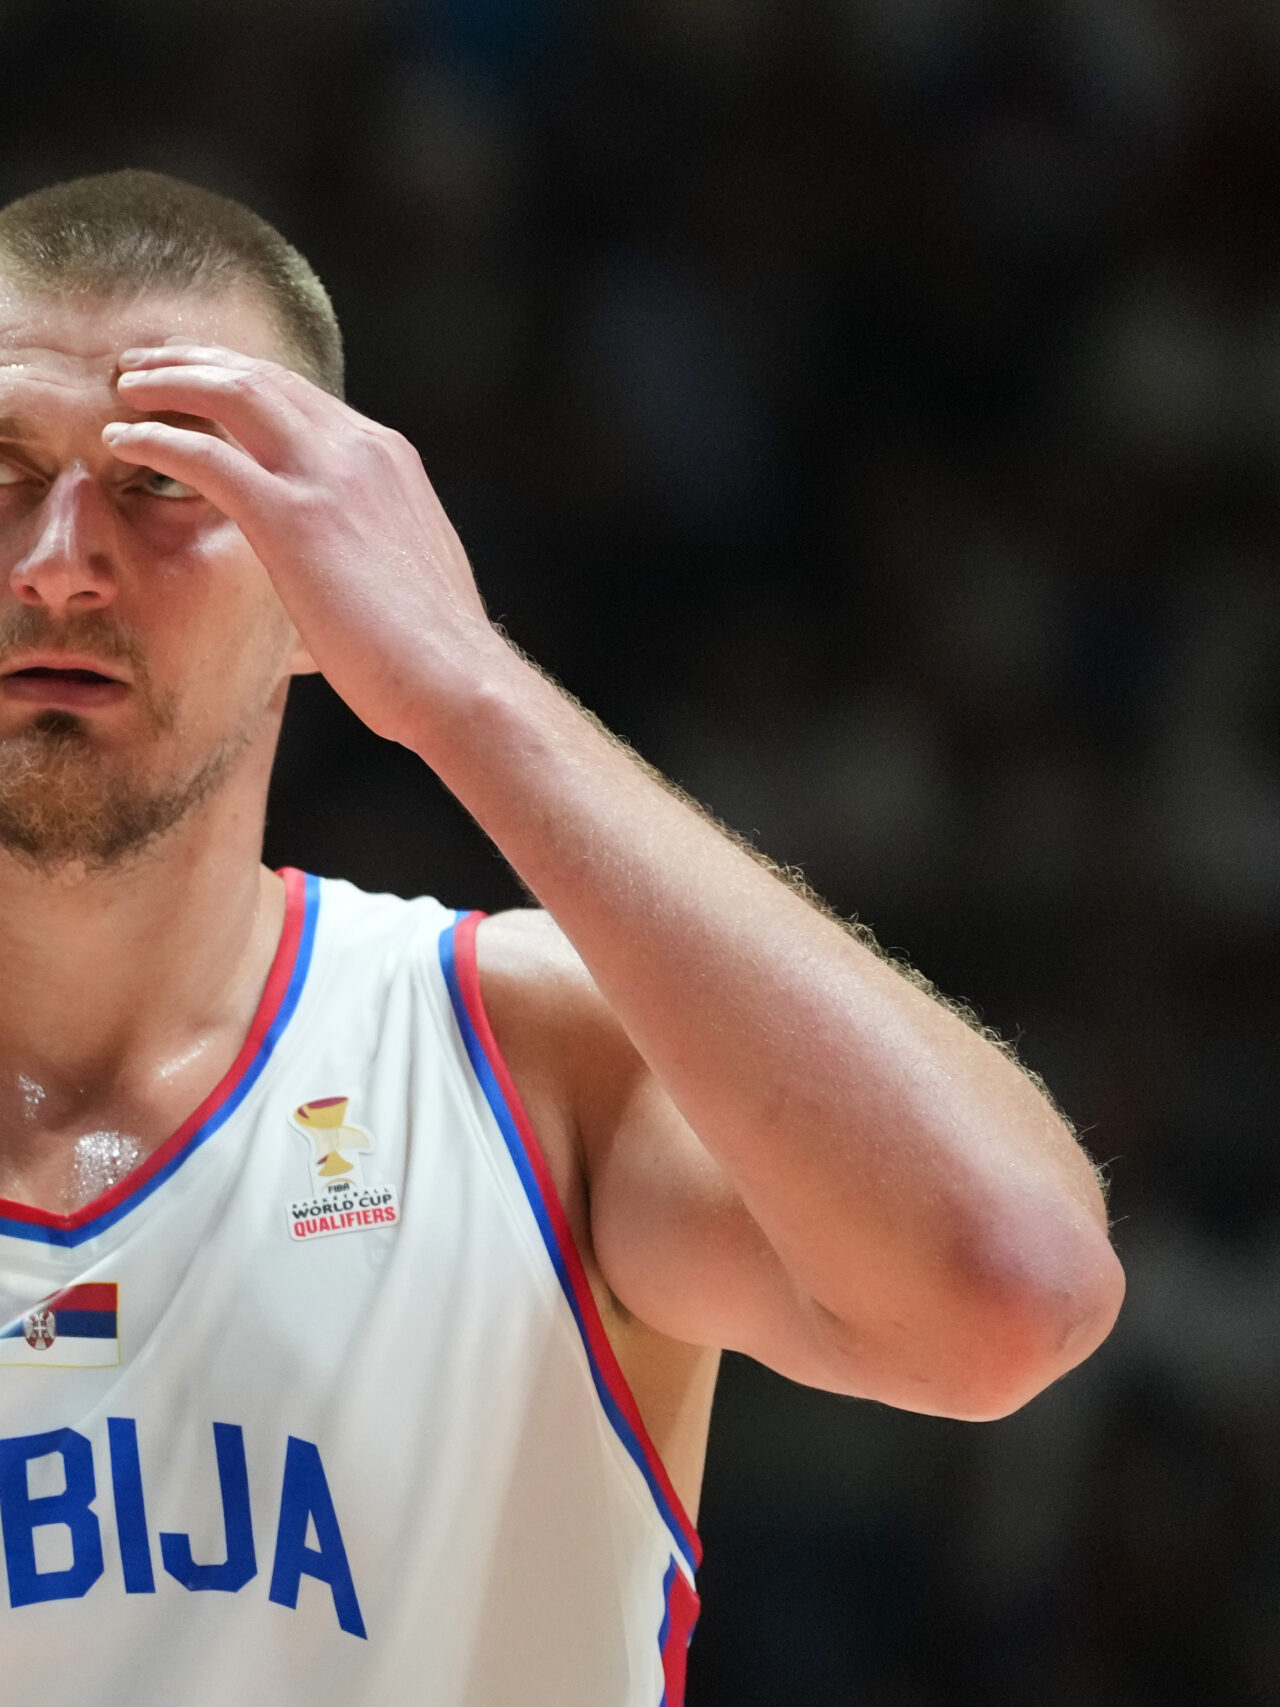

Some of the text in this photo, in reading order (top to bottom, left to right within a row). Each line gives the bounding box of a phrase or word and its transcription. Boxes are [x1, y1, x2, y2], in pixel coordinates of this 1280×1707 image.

[328, 1182, 350, 1194] FIBA
[292, 1193, 392, 1220] WORLD CUP
[293, 1206, 397, 1238] QUALIFIERS
